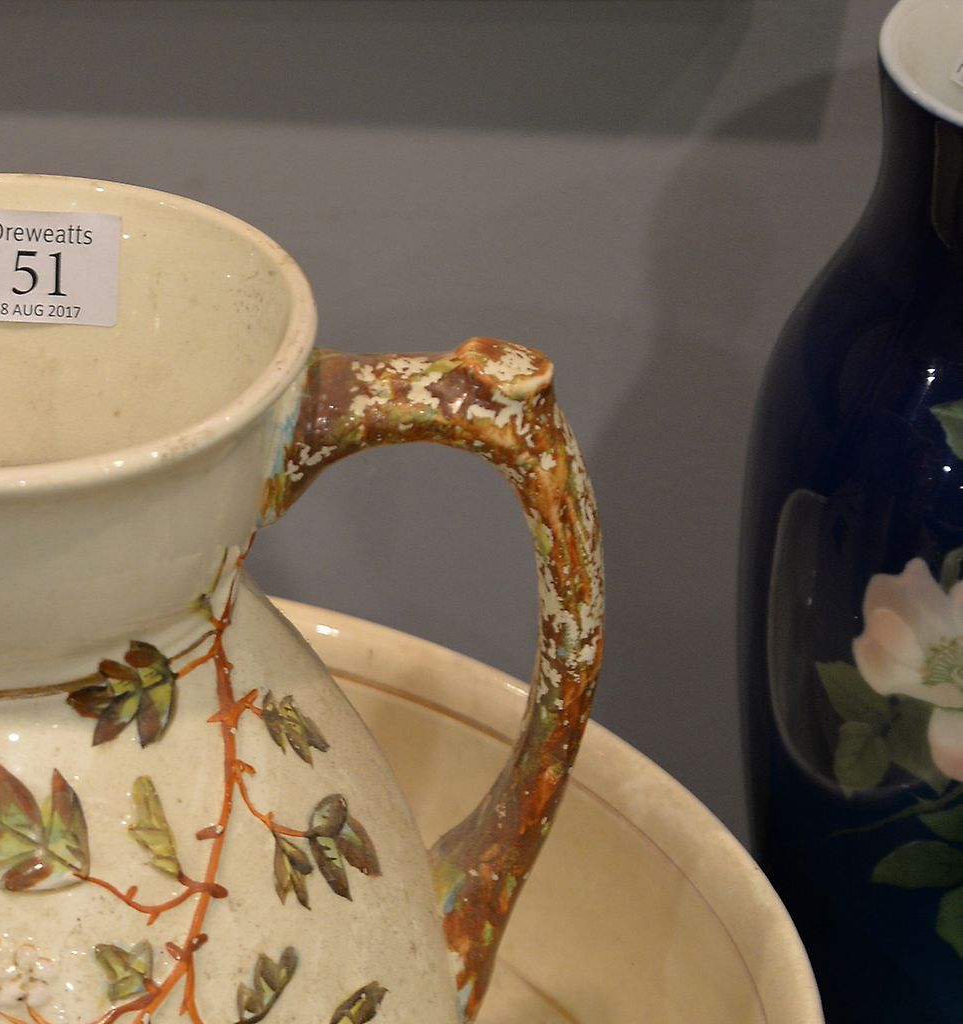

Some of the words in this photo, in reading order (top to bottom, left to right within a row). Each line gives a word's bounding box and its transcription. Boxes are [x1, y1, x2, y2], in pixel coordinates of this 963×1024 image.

[12, 250, 67, 296] 51
[13, 304, 44, 316] AUG
[48, 305, 81, 318] 2017
